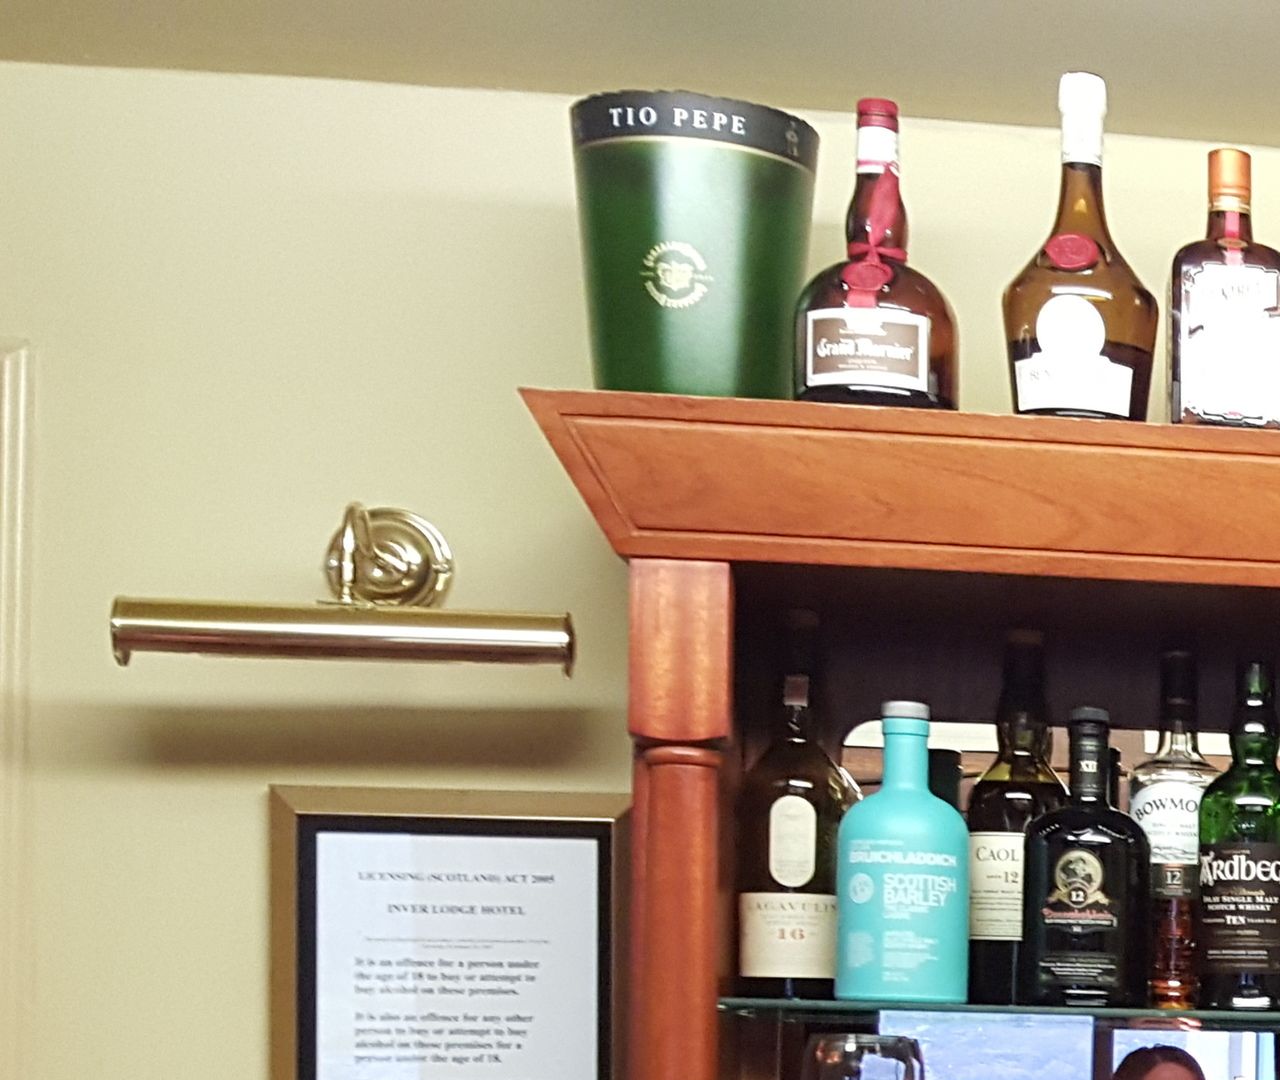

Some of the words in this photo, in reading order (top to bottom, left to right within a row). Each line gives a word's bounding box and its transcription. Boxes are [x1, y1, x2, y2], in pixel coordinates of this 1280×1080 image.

[609, 107, 657, 127] TIO
[673, 107, 746, 135] PEPE
[976, 846, 1019, 862] CAOL
[504, 874, 527, 883] ACT
[1003, 870, 1019, 883] 12
[1165, 870, 1182, 884] 12
[883, 873, 957, 893] SCOTTISH
[883, 888, 945, 906] BARLEY
[1221, 895, 1253, 903] SINGLE
[1255, 894, 1279, 904] MALT
[387, 904, 428, 915] INVER
[432, 904, 477, 915] LODGE
[481, 905, 526, 916] HOTEL
[1225, 914, 1246, 925] TEN
[777, 927, 805, 940] 16
[468, 958, 504, 970] person
[507, 958, 539, 969] under
[441, 971, 460, 982] buy
[479, 971, 521, 983] attempt
[438, 984, 465, 995] these
[468, 985, 519, 995] premises.
